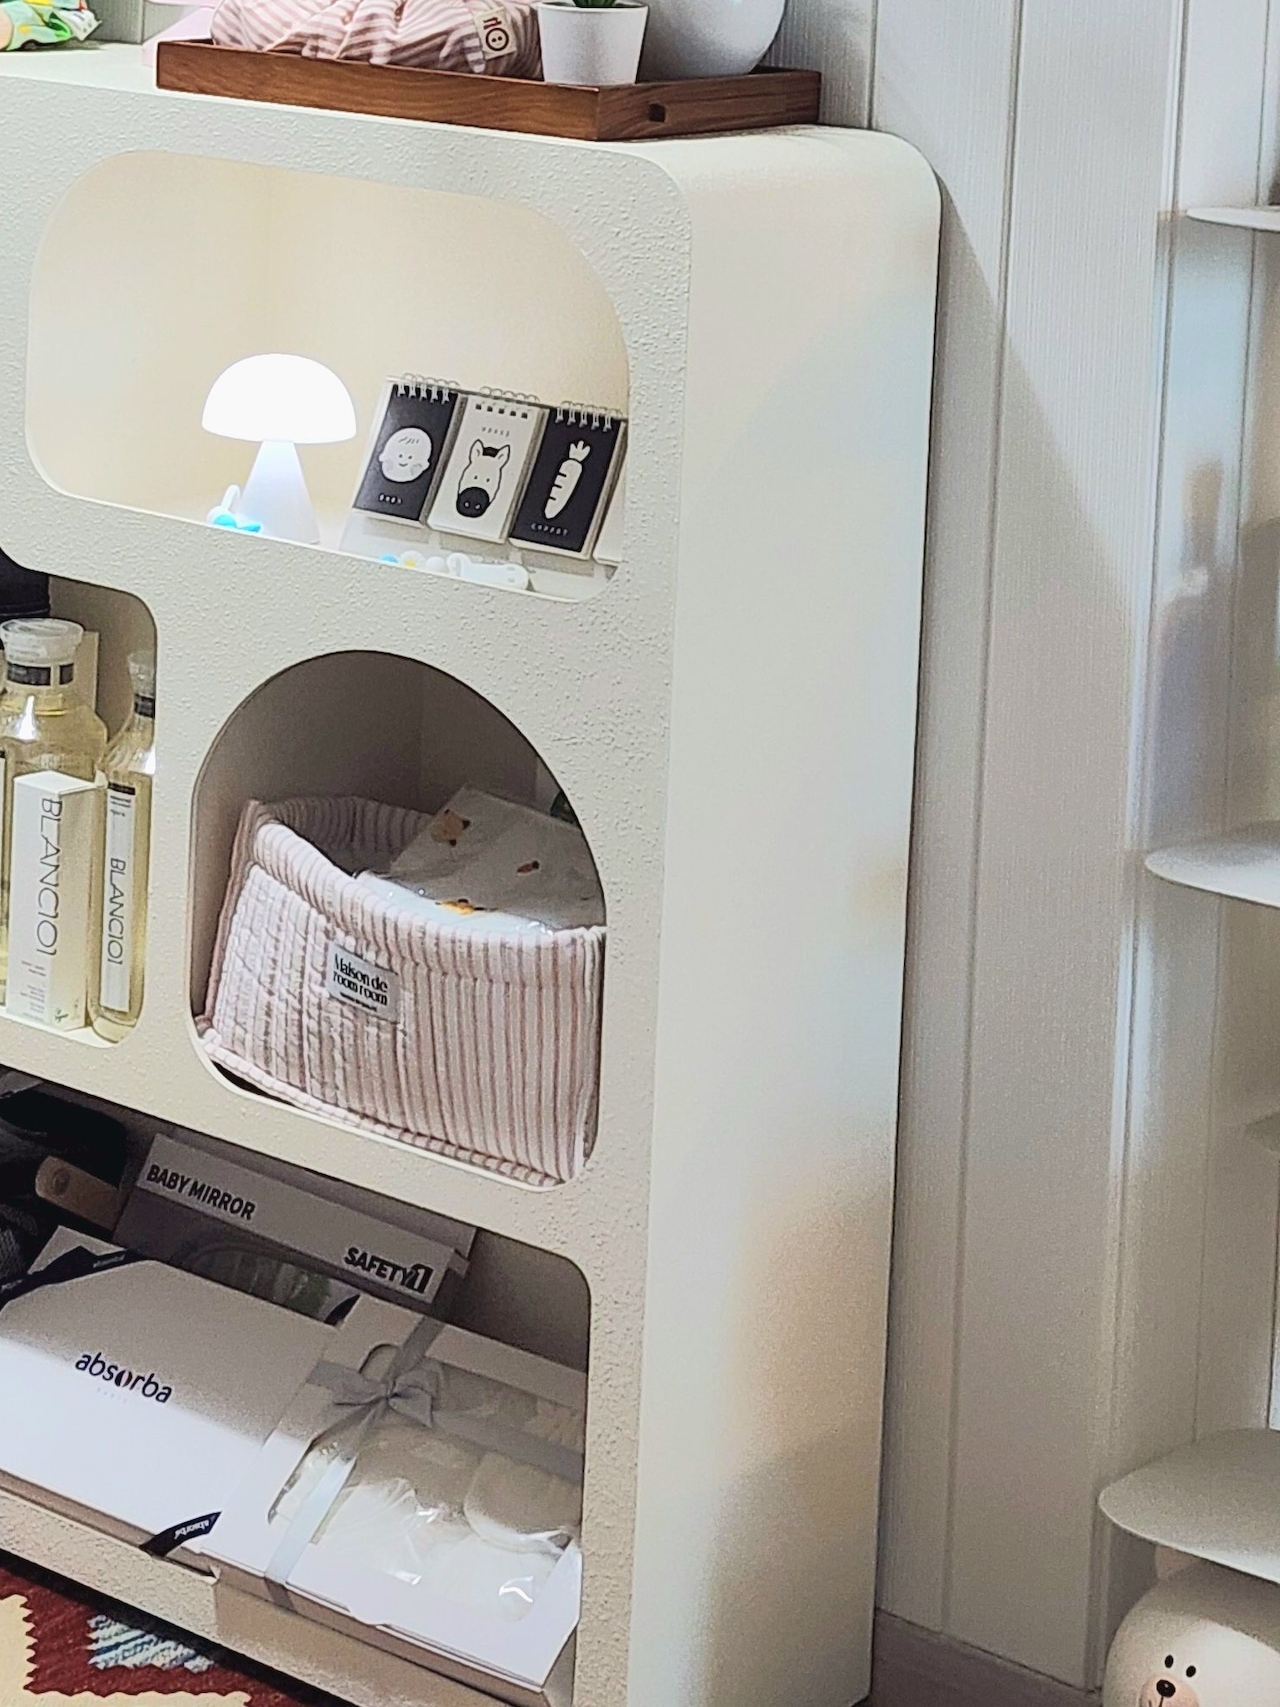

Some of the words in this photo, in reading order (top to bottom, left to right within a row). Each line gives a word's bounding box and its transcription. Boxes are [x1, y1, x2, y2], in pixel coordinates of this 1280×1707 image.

[371, 976, 388, 993] de
[146, 1164, 191, 1194] BABY
[187, 1180, 256, 1221] MIRROR
[75, 1351, 173, 1404] absorba
